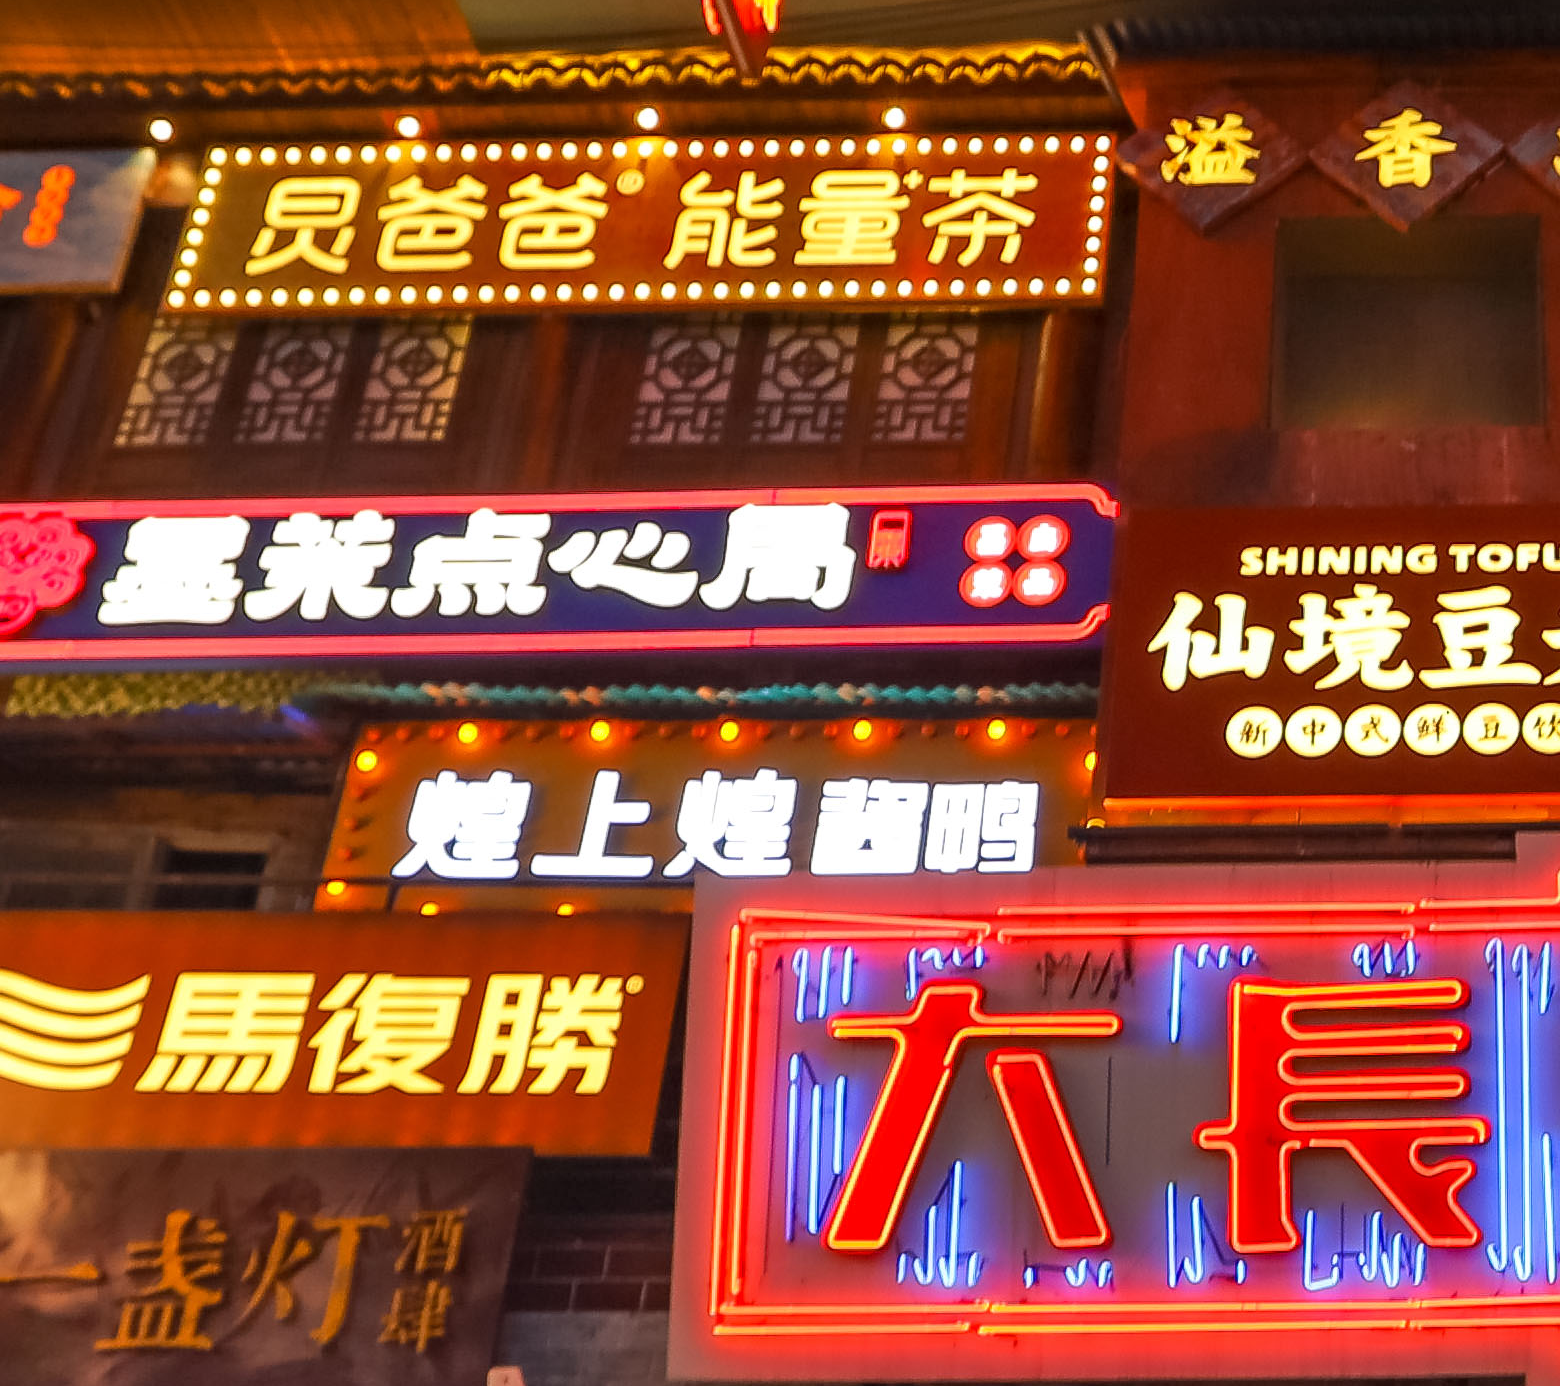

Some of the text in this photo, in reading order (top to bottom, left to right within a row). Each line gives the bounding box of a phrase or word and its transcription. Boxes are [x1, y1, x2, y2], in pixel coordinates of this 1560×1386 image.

[1239, 543, 1438, 576] SHINING
[134, 971, 627, 1096] 馬復勝
